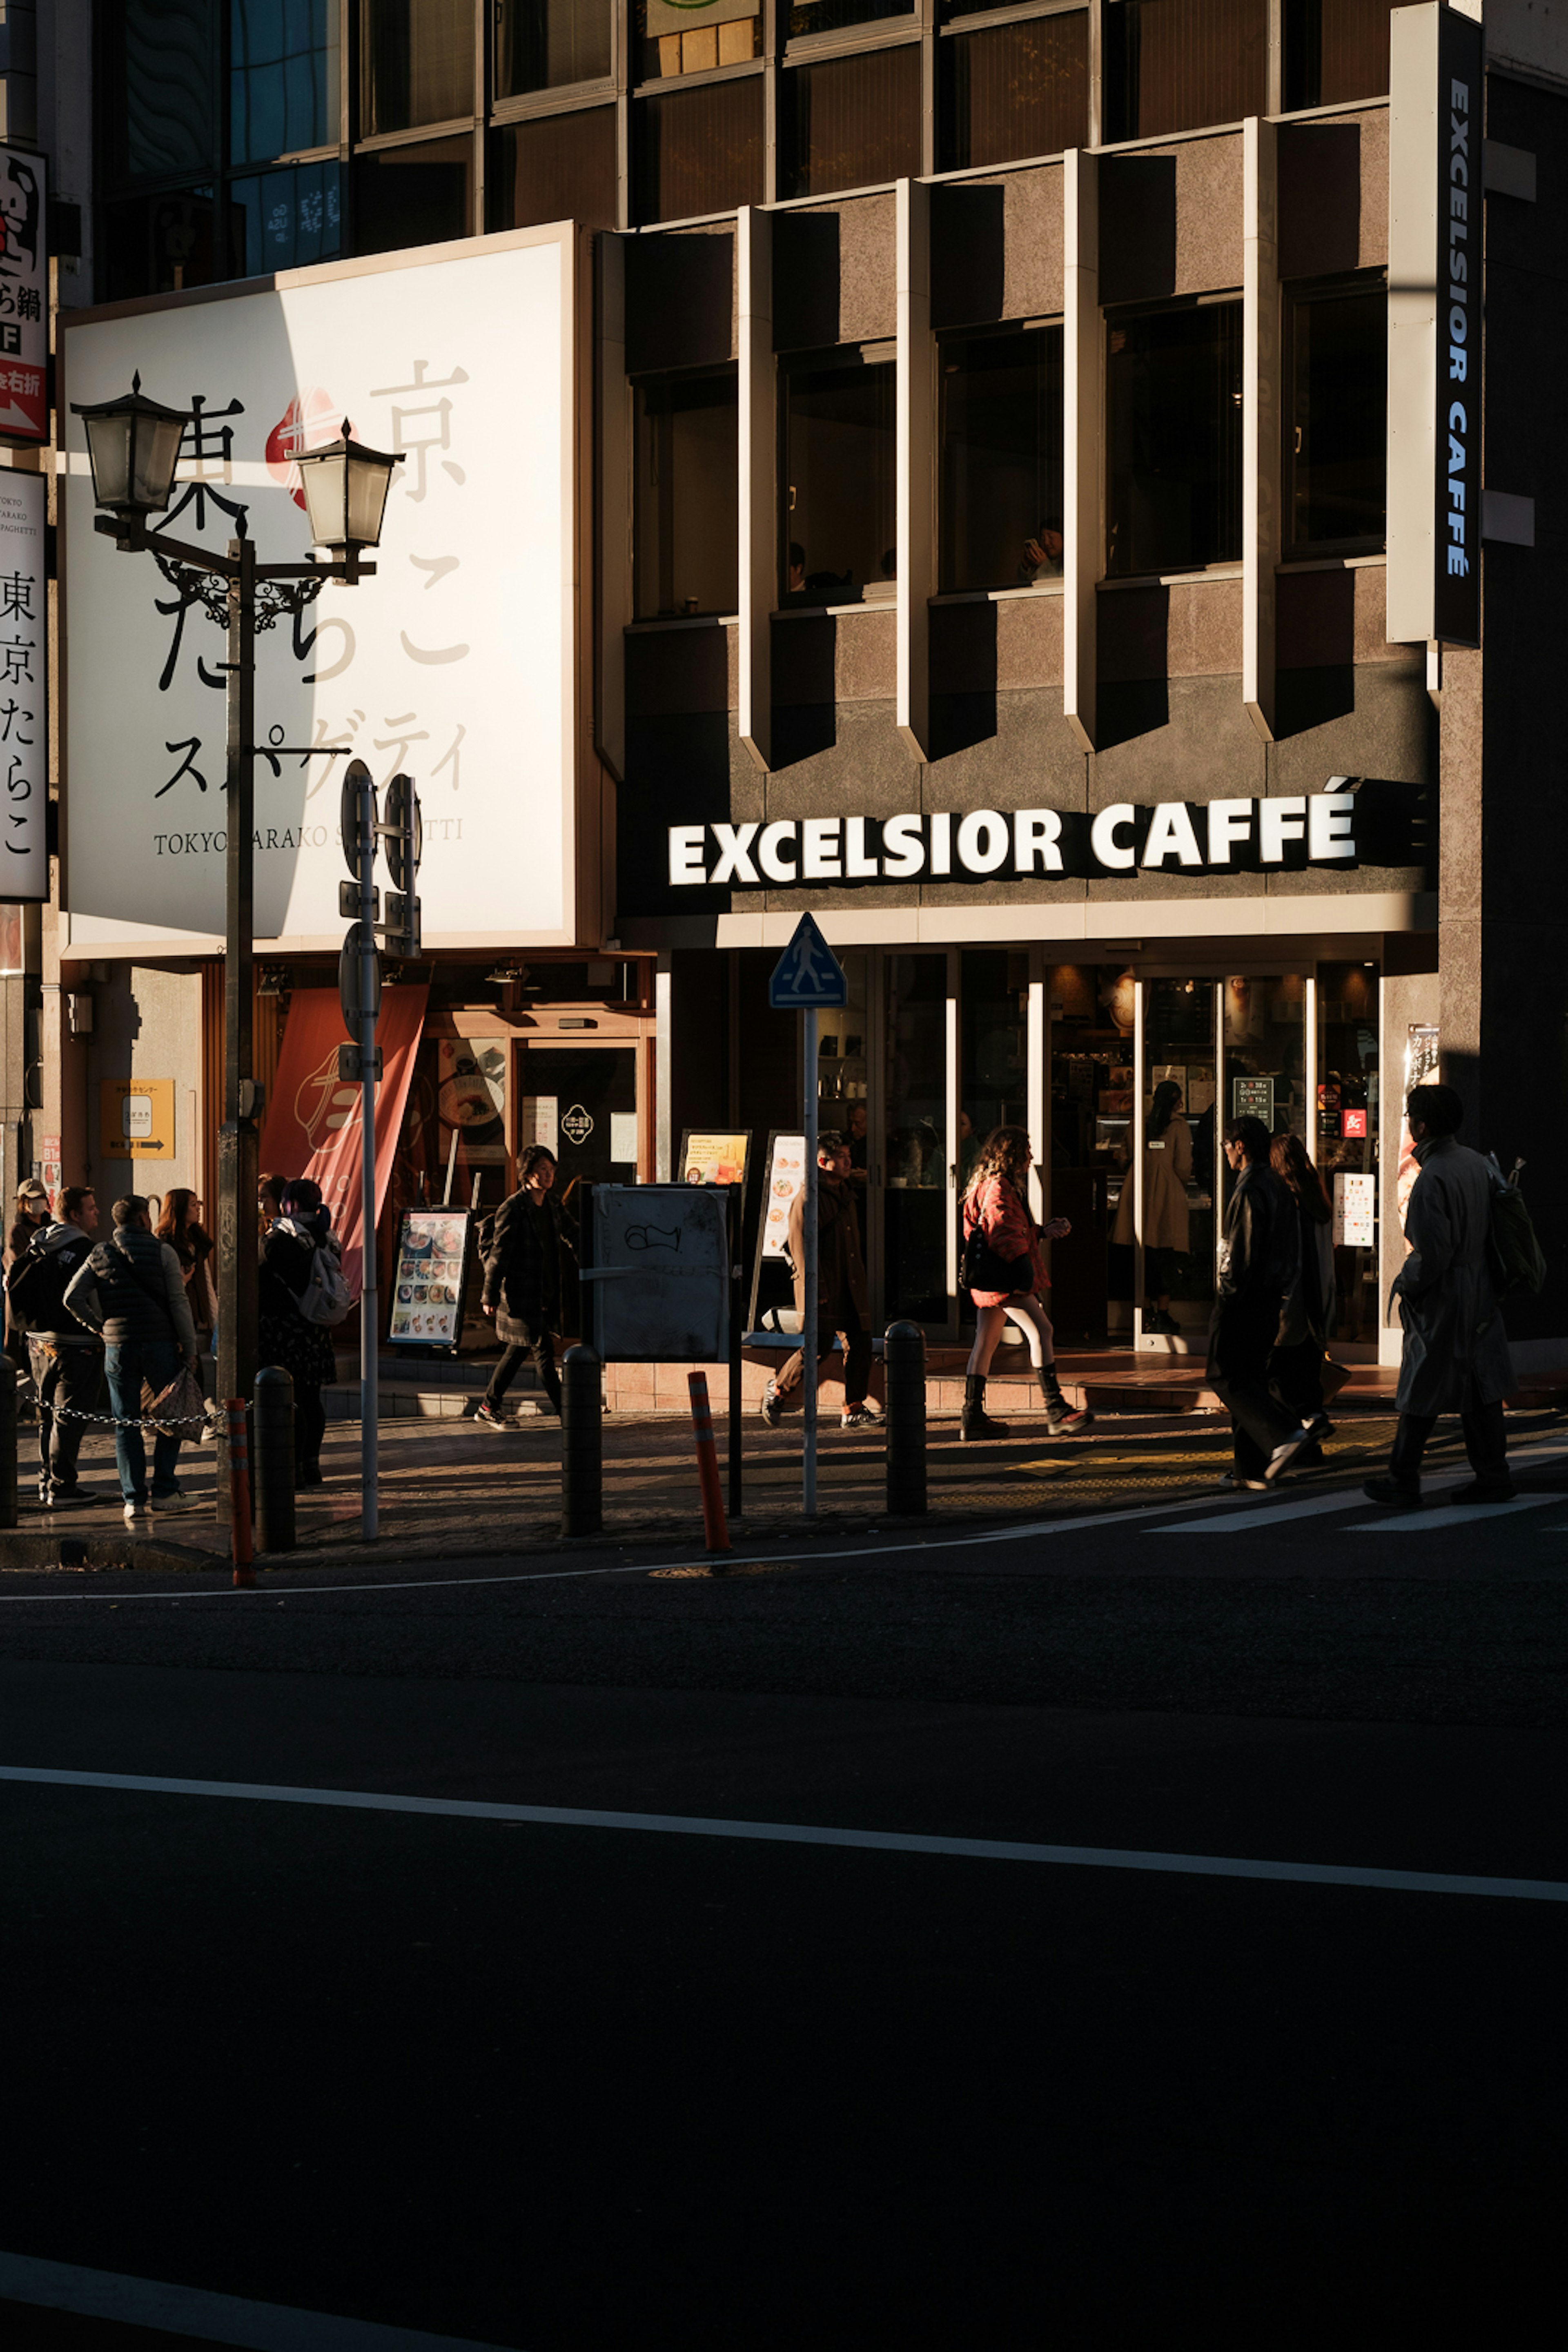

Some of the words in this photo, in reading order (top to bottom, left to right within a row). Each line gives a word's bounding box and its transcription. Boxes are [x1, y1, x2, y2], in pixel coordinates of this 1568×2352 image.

[1449, 78, 1470, 383] EXCELSIOR
[1448, 401, 1469, 577] CAFFÉ
[0, 571, 36, 854] 東京たらこ
[154, 831, 227, 855] TOKYO
[252, 824, 327, 850] ARAKO
[670, 809, 1063, 885] EXCELSIOR
[1092, 776, 1356, 869] CAFFÉ
